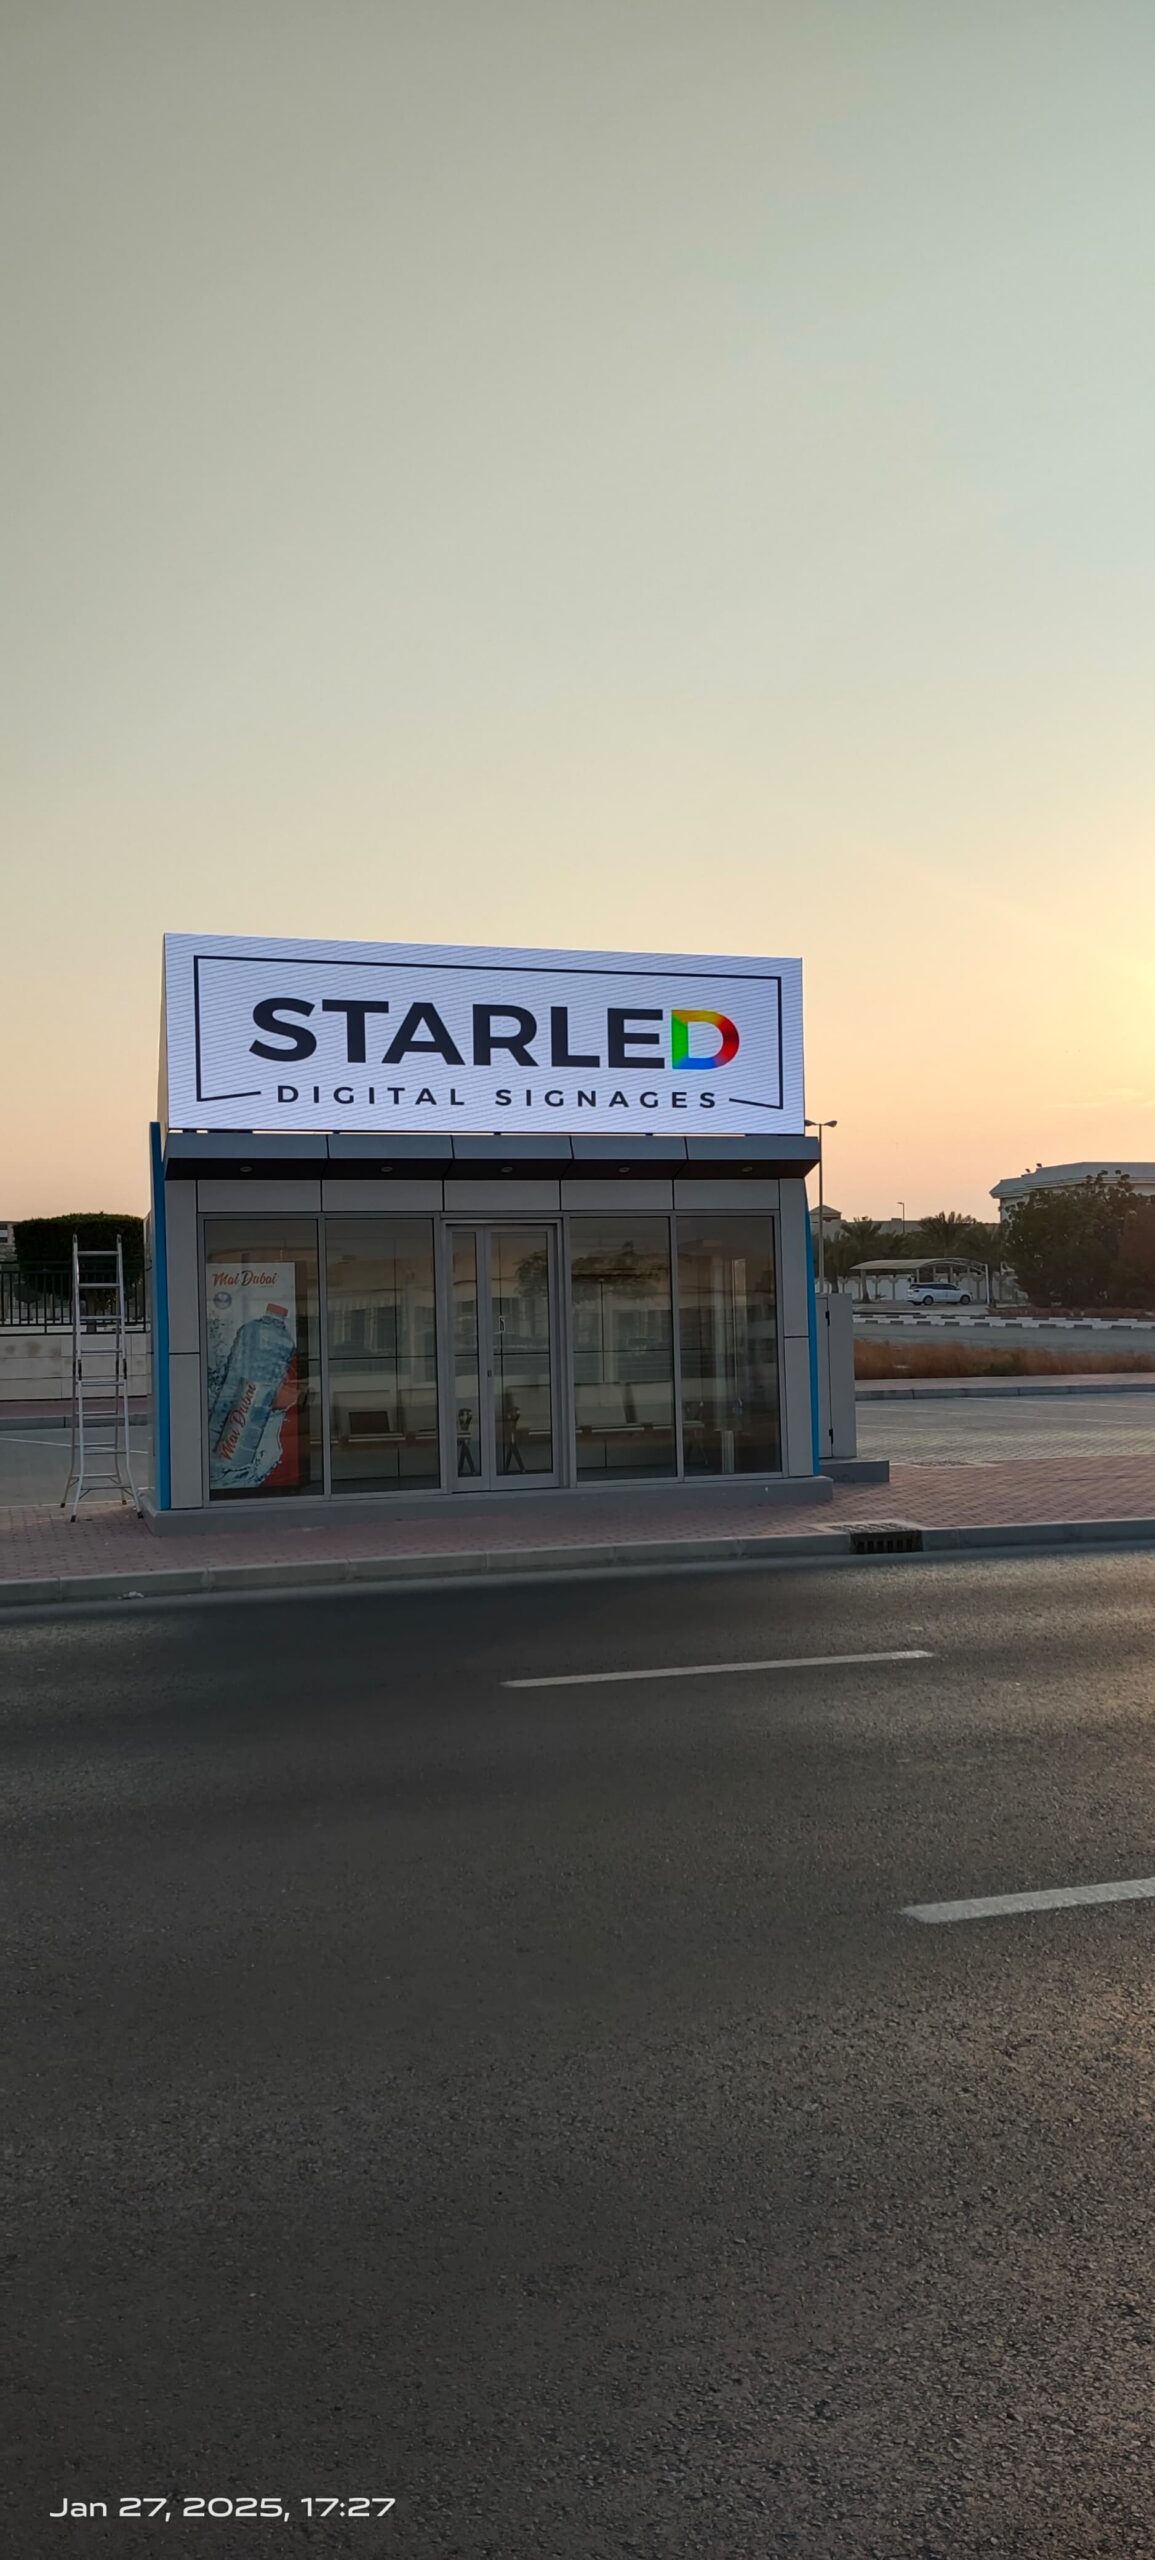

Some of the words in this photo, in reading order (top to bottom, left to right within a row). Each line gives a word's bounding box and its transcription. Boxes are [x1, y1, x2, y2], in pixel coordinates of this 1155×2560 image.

[249, 997, 740, 1071] STARLED
[277, 1085, 465, 1106] DIGITAL
[496, 1089, 717, 1109] SIGNAGES
[212, 1272, 240, 1287] Mai
[241, 1270, 278, 1287] Dubai
[220, 1430, 240, 1460] Mai
